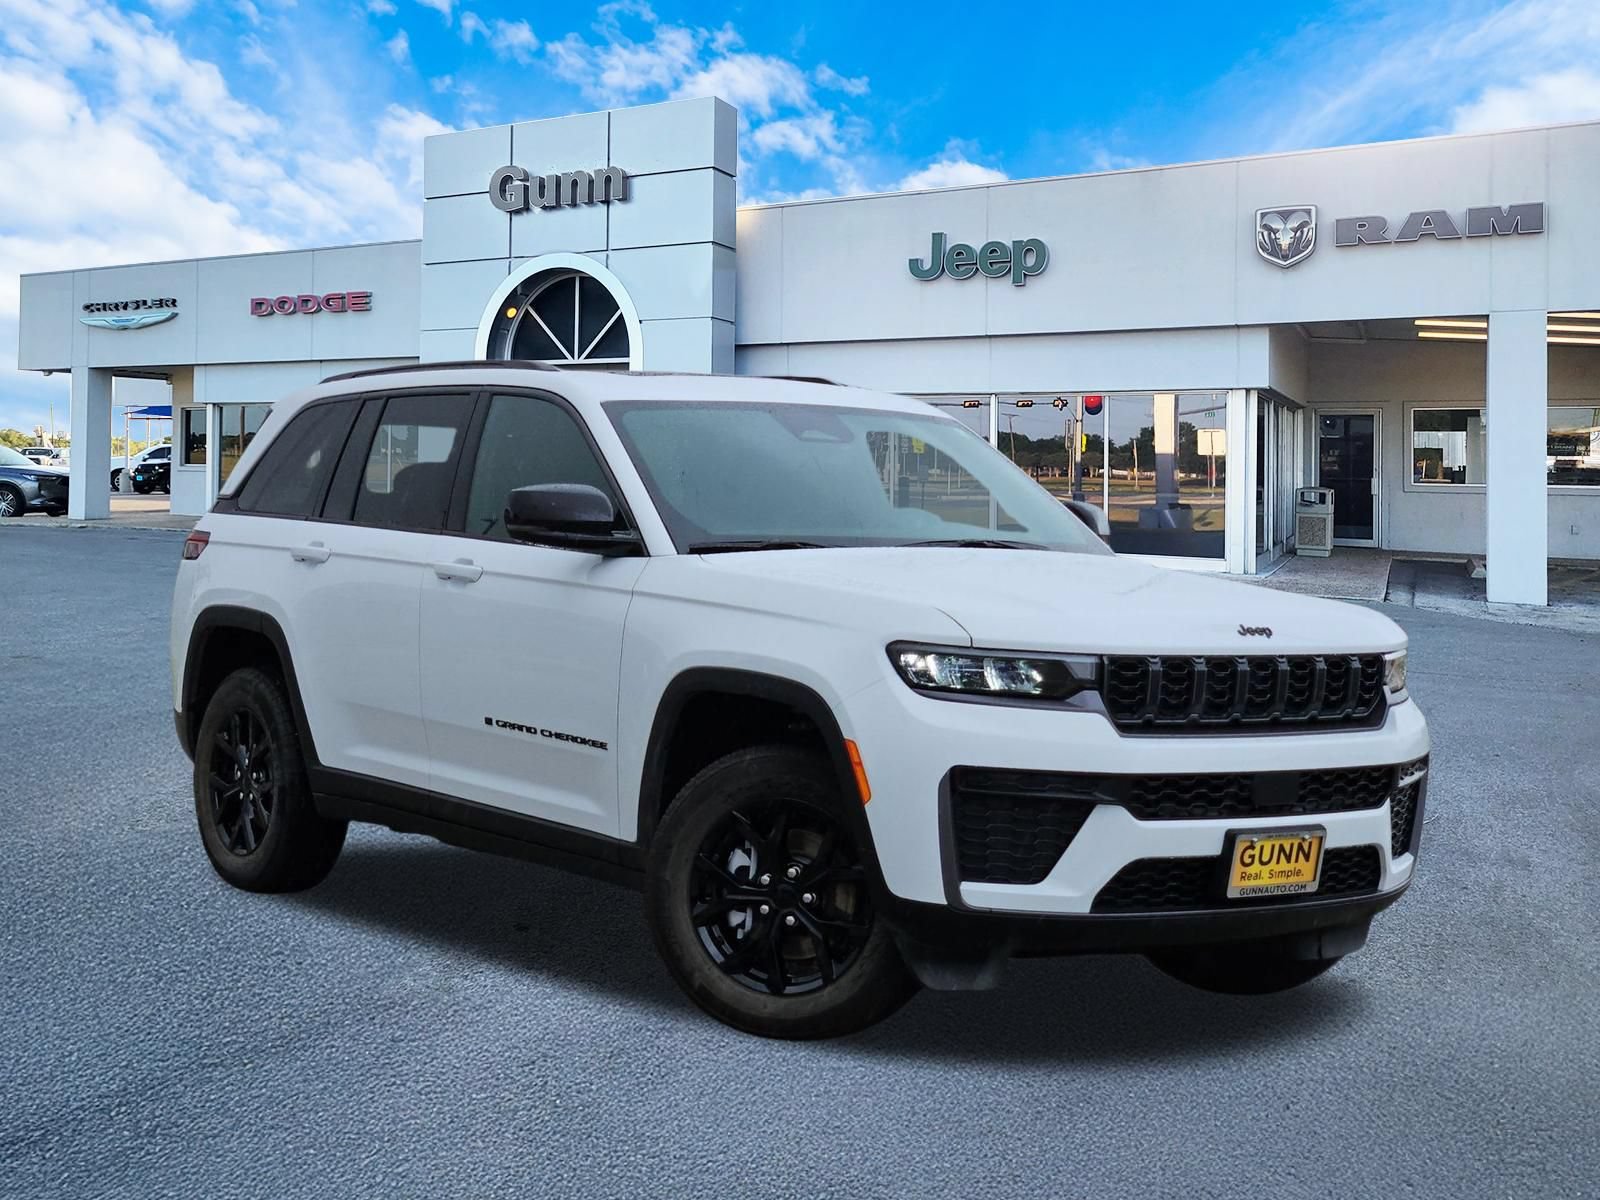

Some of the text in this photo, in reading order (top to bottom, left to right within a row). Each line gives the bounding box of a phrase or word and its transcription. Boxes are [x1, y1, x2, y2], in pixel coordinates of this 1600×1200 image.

[489, 165, 628, 212] Gunn
[1335, 202, 1545, 247] RAM
[908, 231, 1048, 286] Jeep
[82, 298, 177, 313] CHRYSLER
[250, 291, 373, 317] DODGE
[1237, 624, 1273, 639] Jeep
[495, 719, 609, 751] GRAND CHEROKEE
[1240, 841, 1313, 868] GUNN
[1240, 867, 1304, 881] Real. Simple.
[1240, 884, 1307, 896] GUNNAUTO.COM
